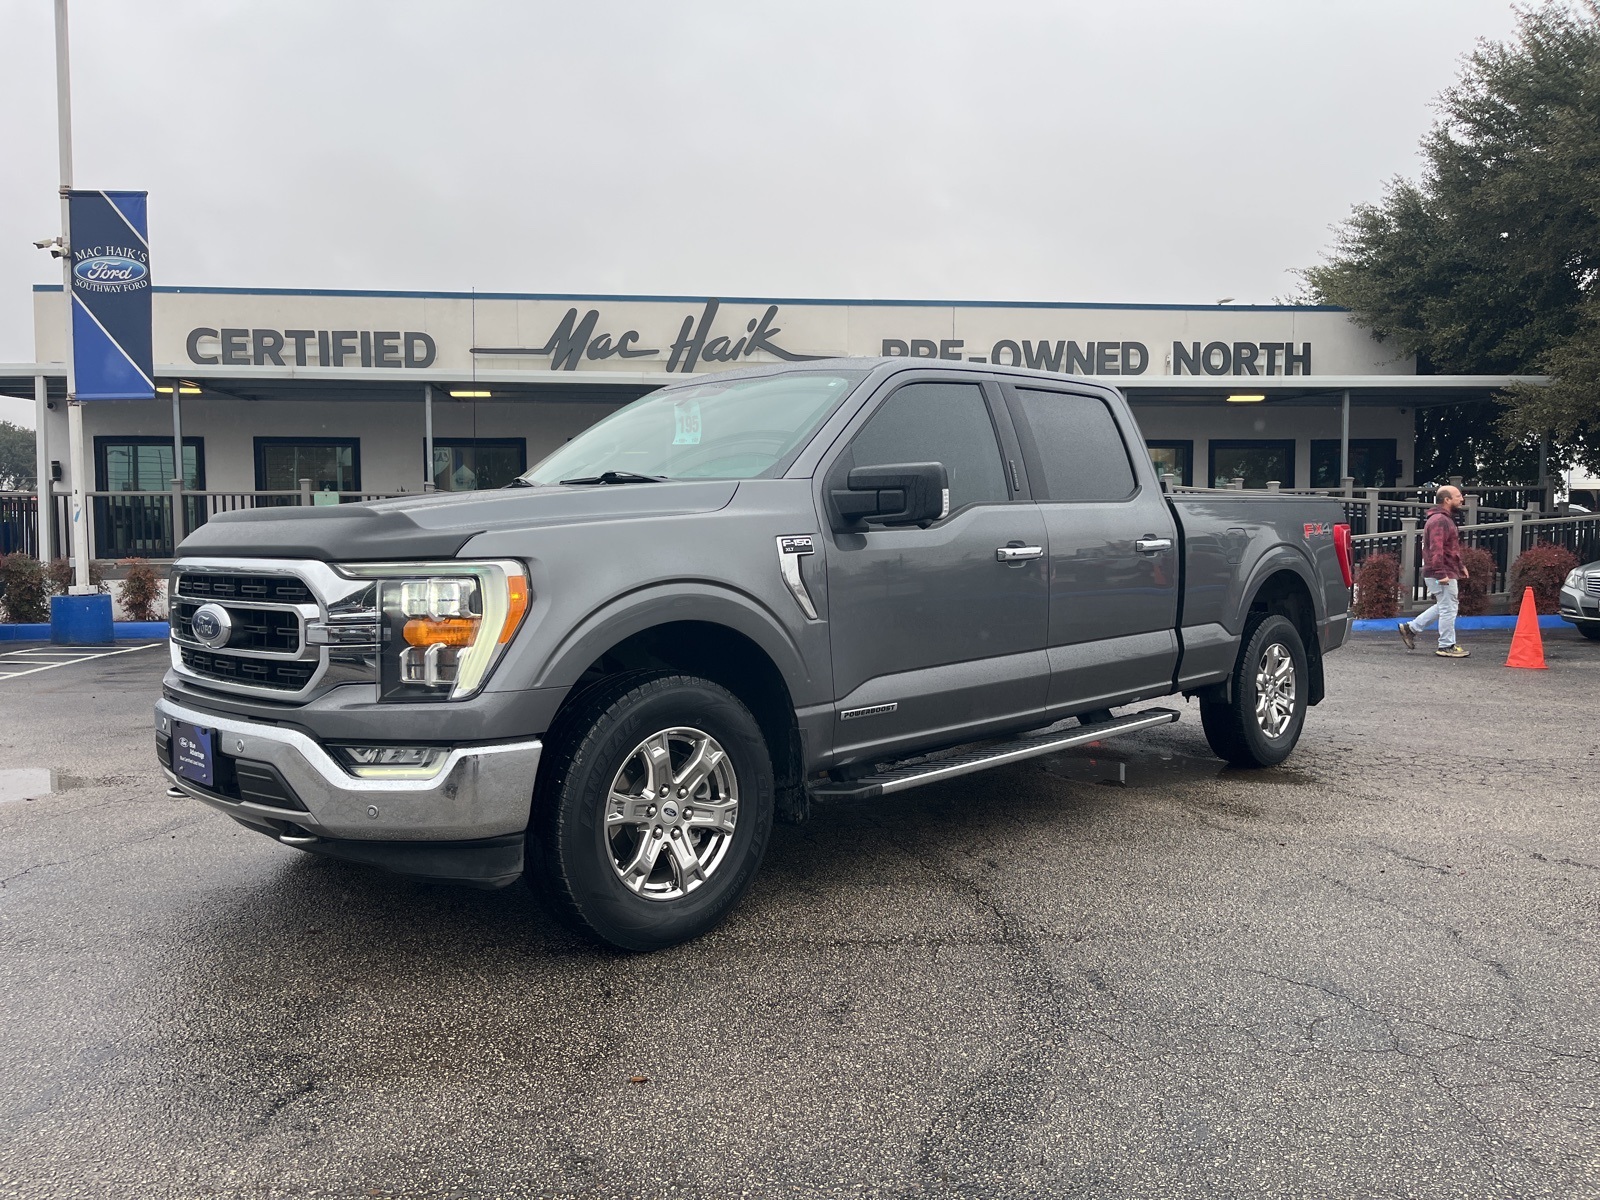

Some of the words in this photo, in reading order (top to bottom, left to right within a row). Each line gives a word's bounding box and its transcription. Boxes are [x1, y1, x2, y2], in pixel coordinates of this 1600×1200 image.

[74, 246, 102, 261] MAC
[105, 245, 148, 263] HAIK'S
[87, 260, 133, 280] Ford
[74, 279, 122, 293] SOUTHWAY
[123, 279, 148, 292] FORD
[470, 308, 660, 371] Mac
[666, 298, 845, 373] Haik
[186, 327, 437, 368] CERTIFIED
[1173, 341, 1311, 376] NORTH
[680, 415, 699, 434] 195
[1303, 522, 1332, 539] FX4
[782, 539, 812, 547] F-150
[196, 615, 214, 635] Ford
[844, 704, 896, 719] POWERBOOST
